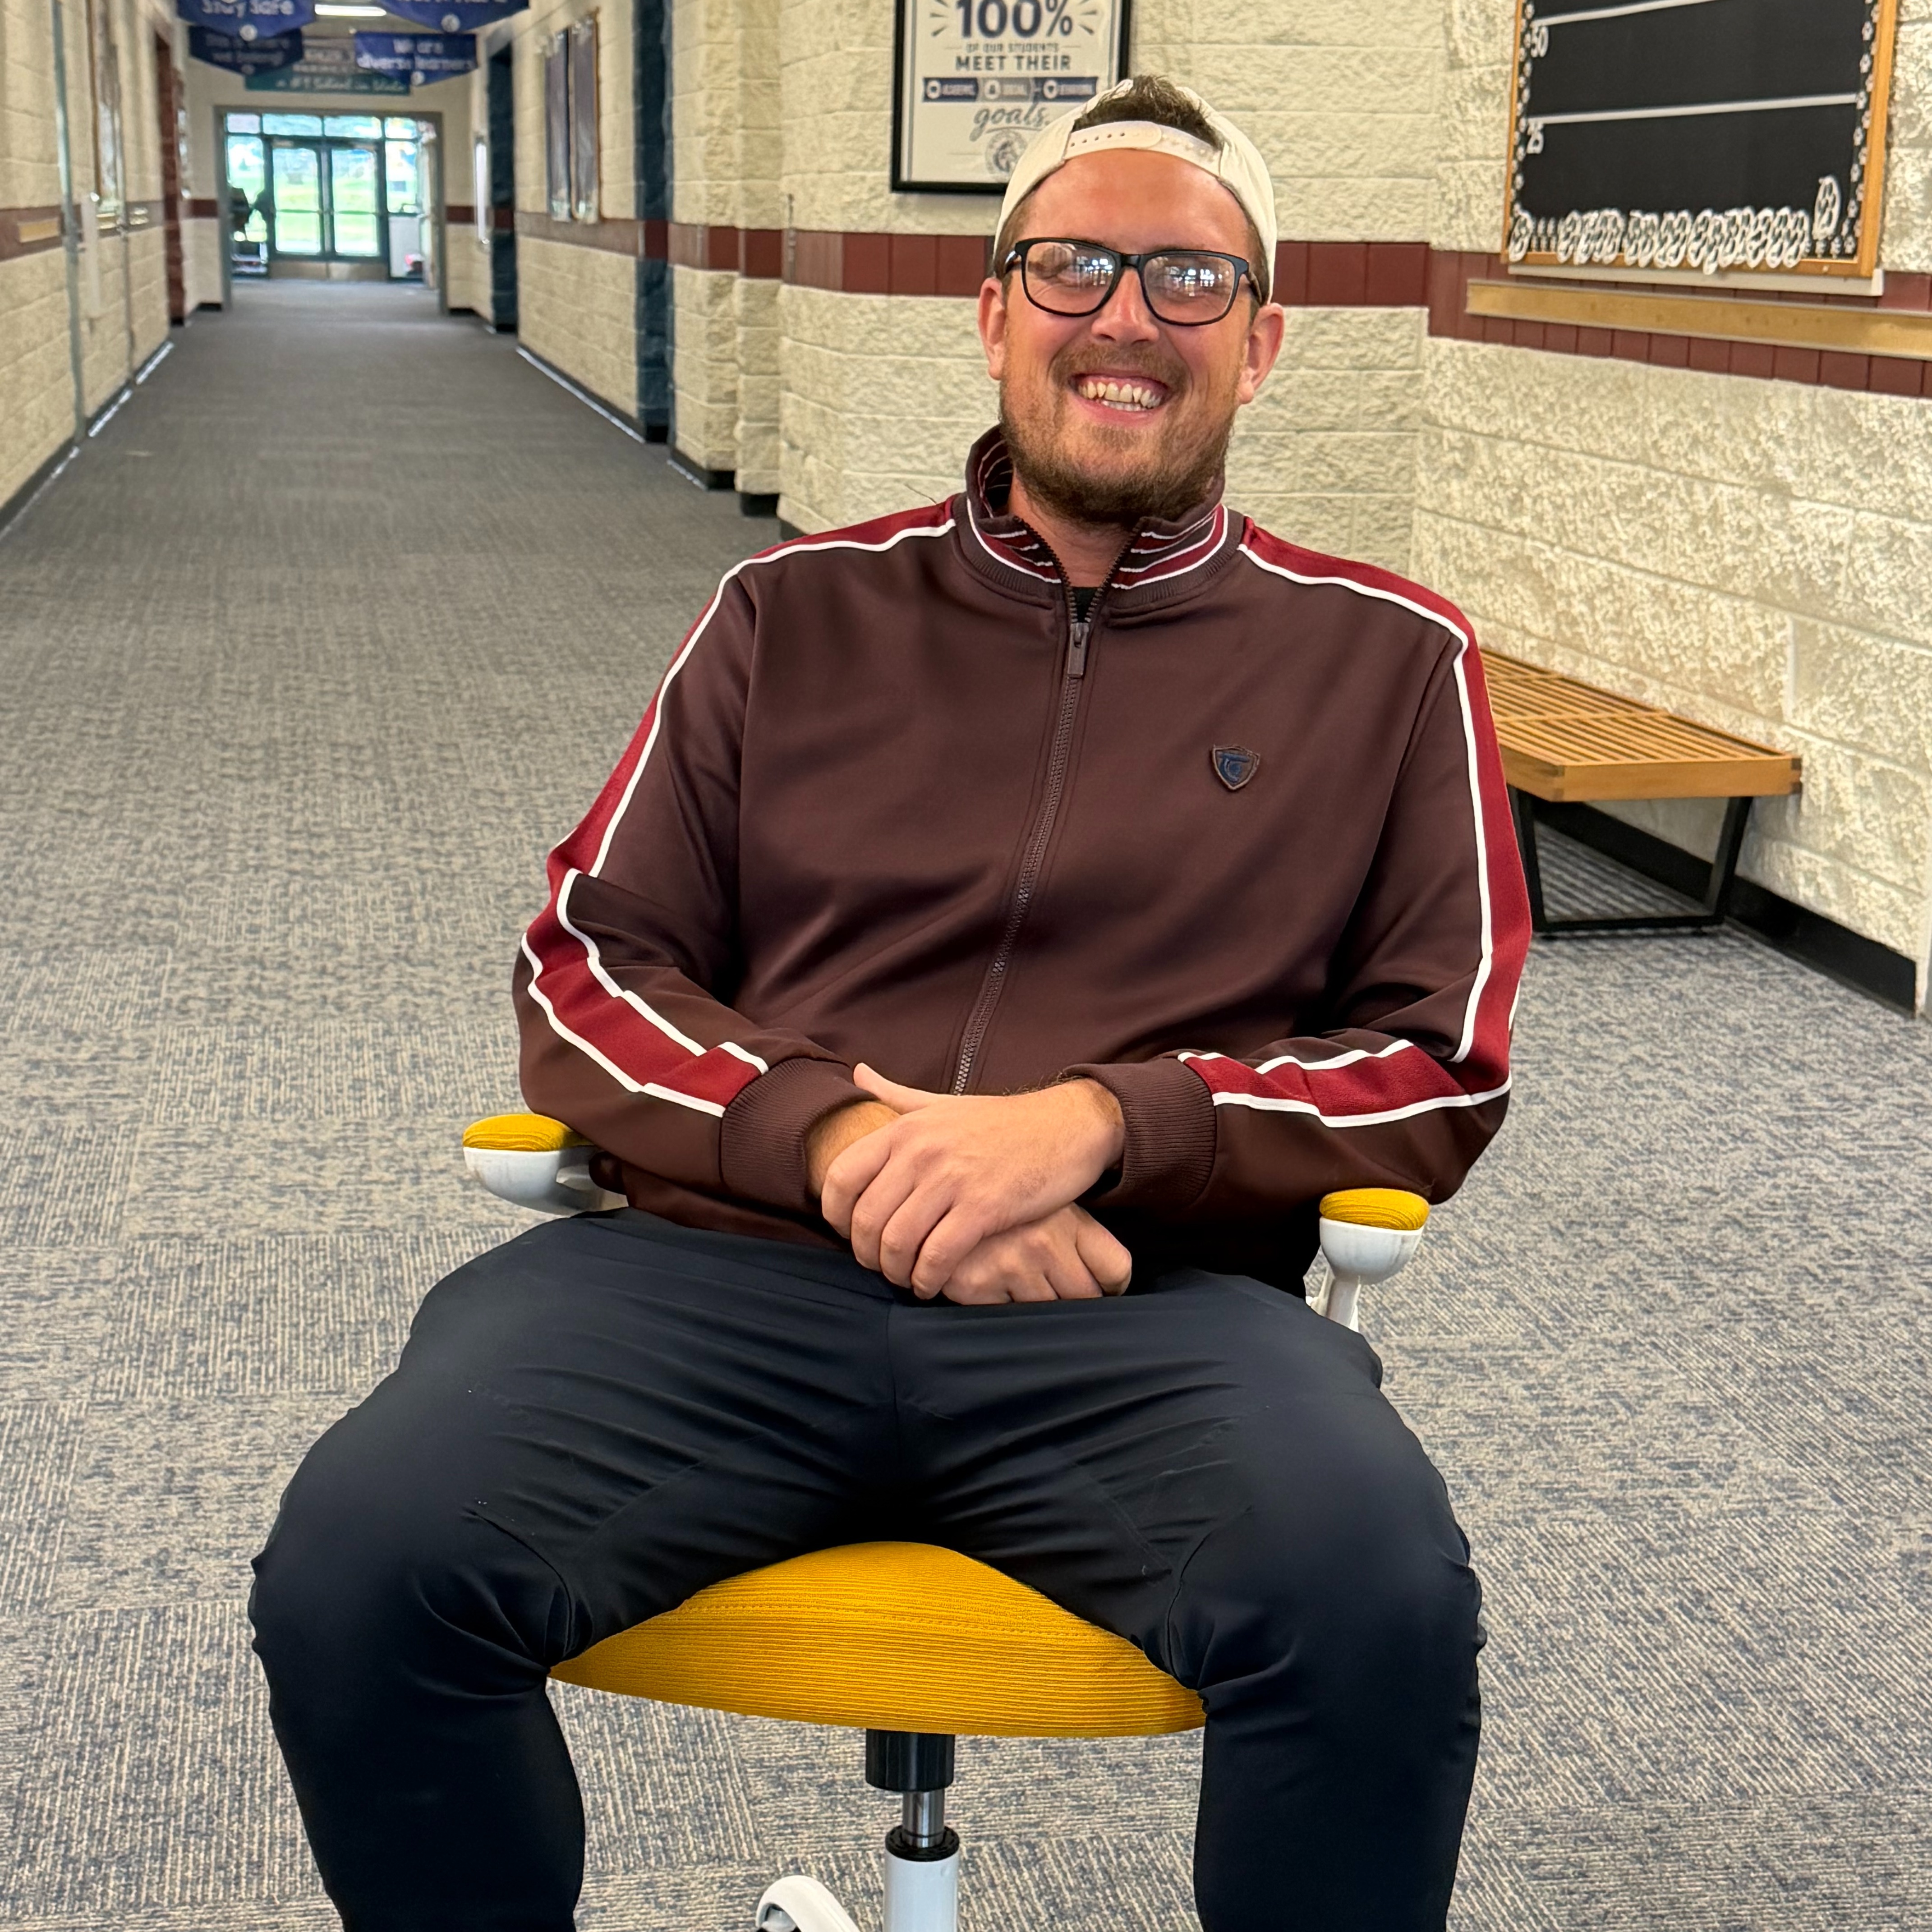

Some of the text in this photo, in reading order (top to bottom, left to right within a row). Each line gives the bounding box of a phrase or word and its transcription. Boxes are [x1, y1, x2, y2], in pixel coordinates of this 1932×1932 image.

[250, 0, 294, 15] Safe
[956, 0, 1072, 38] 100%
[417, 41, 443, 54] are
[1530, 23, 1549, 58] 50
[955, 55, 1072, 71] MEET THEIR
